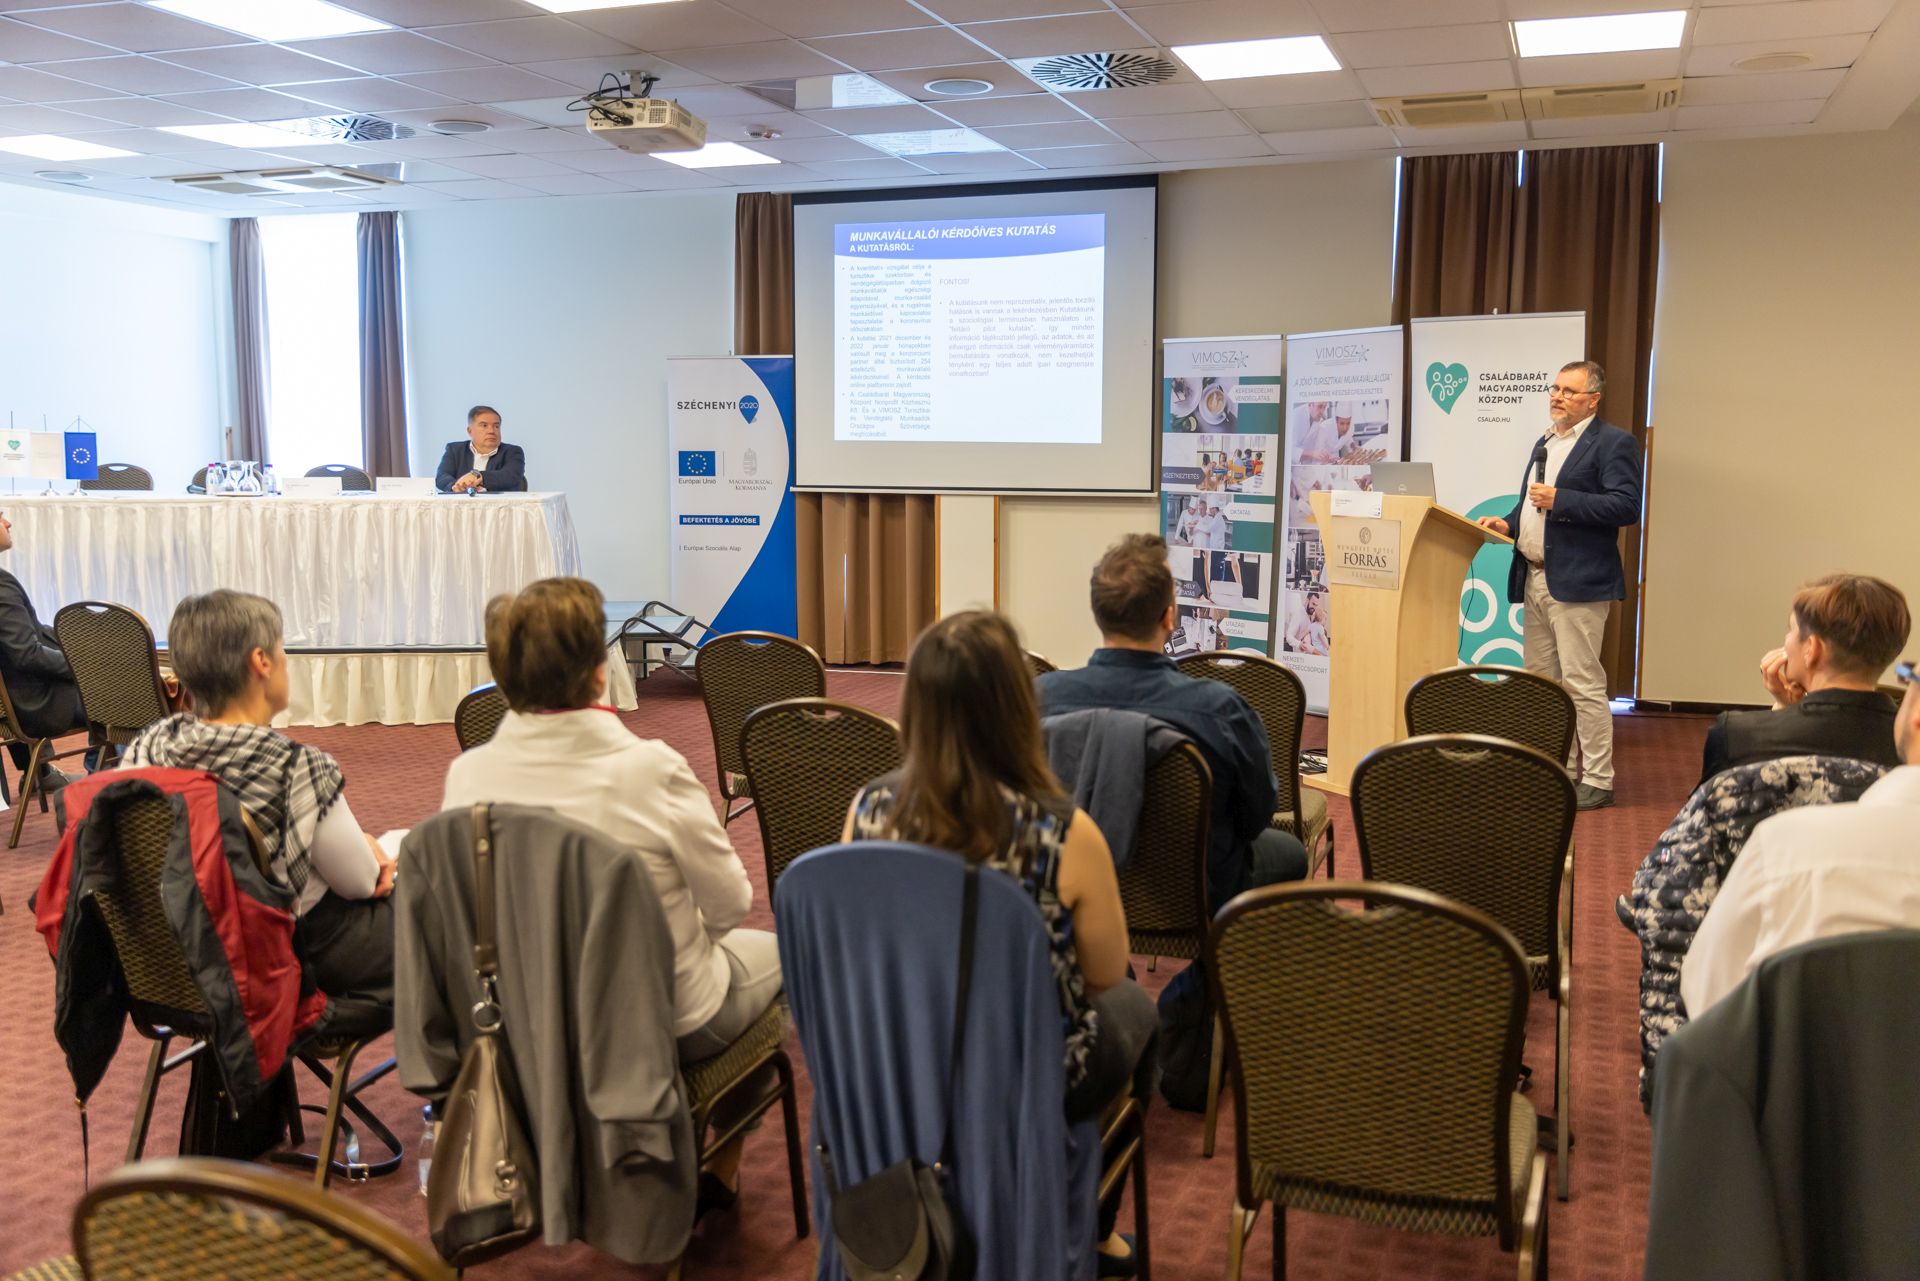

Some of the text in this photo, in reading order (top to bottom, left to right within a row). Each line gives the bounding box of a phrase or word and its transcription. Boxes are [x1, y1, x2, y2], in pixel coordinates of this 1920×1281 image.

[850, 223, 1056, 242] MUNKAVÁLLALÓI KÉRDŐÍVES KUTATÁS
[850, 242, 914, 252] A KUTATÁSRÓL:
[1191, 350, 1236, 363] VIMOSZ
[1315, 345, 1357, 360] VIMOSZ
[1479, 371, 1548, 381] CSALÁDBARÁT
[1479, 382, 1549, 392] MAGYARORSZÁ
[1478, 394, 1523, 404] KÖZPONT
[677, 399, 736, 410] SZÉCHENYI
[678, 477, 701, 485] Európai
[1344, 551, 1387, 568] FORRÁS
